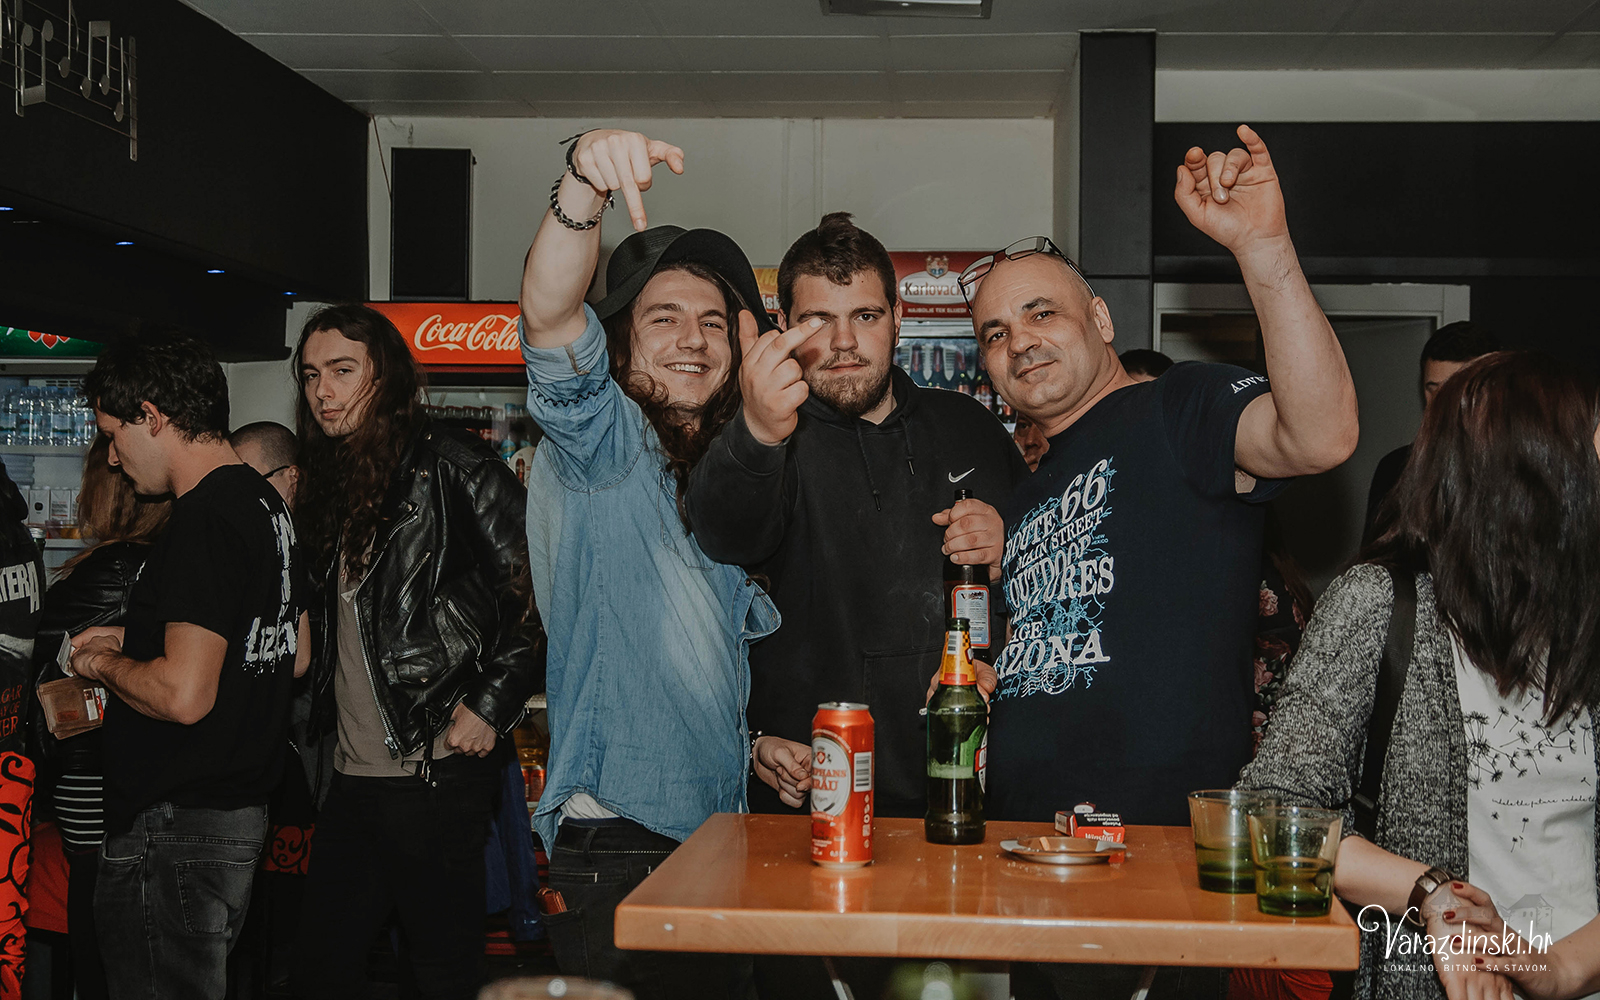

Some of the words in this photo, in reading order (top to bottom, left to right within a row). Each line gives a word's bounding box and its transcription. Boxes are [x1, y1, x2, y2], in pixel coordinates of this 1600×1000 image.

[414, 314, 521, 351] Coca-Cola
[1002, 508, 1057, 568] ROUTE
[1061, 458, 1108, 524] 66
[1016, 538, 1049, 572] MAIN
[1051, 506, 1104, 551] STREET
[0, 561, 40, 614] TERA
[0, 684, 22, 704] GAR
